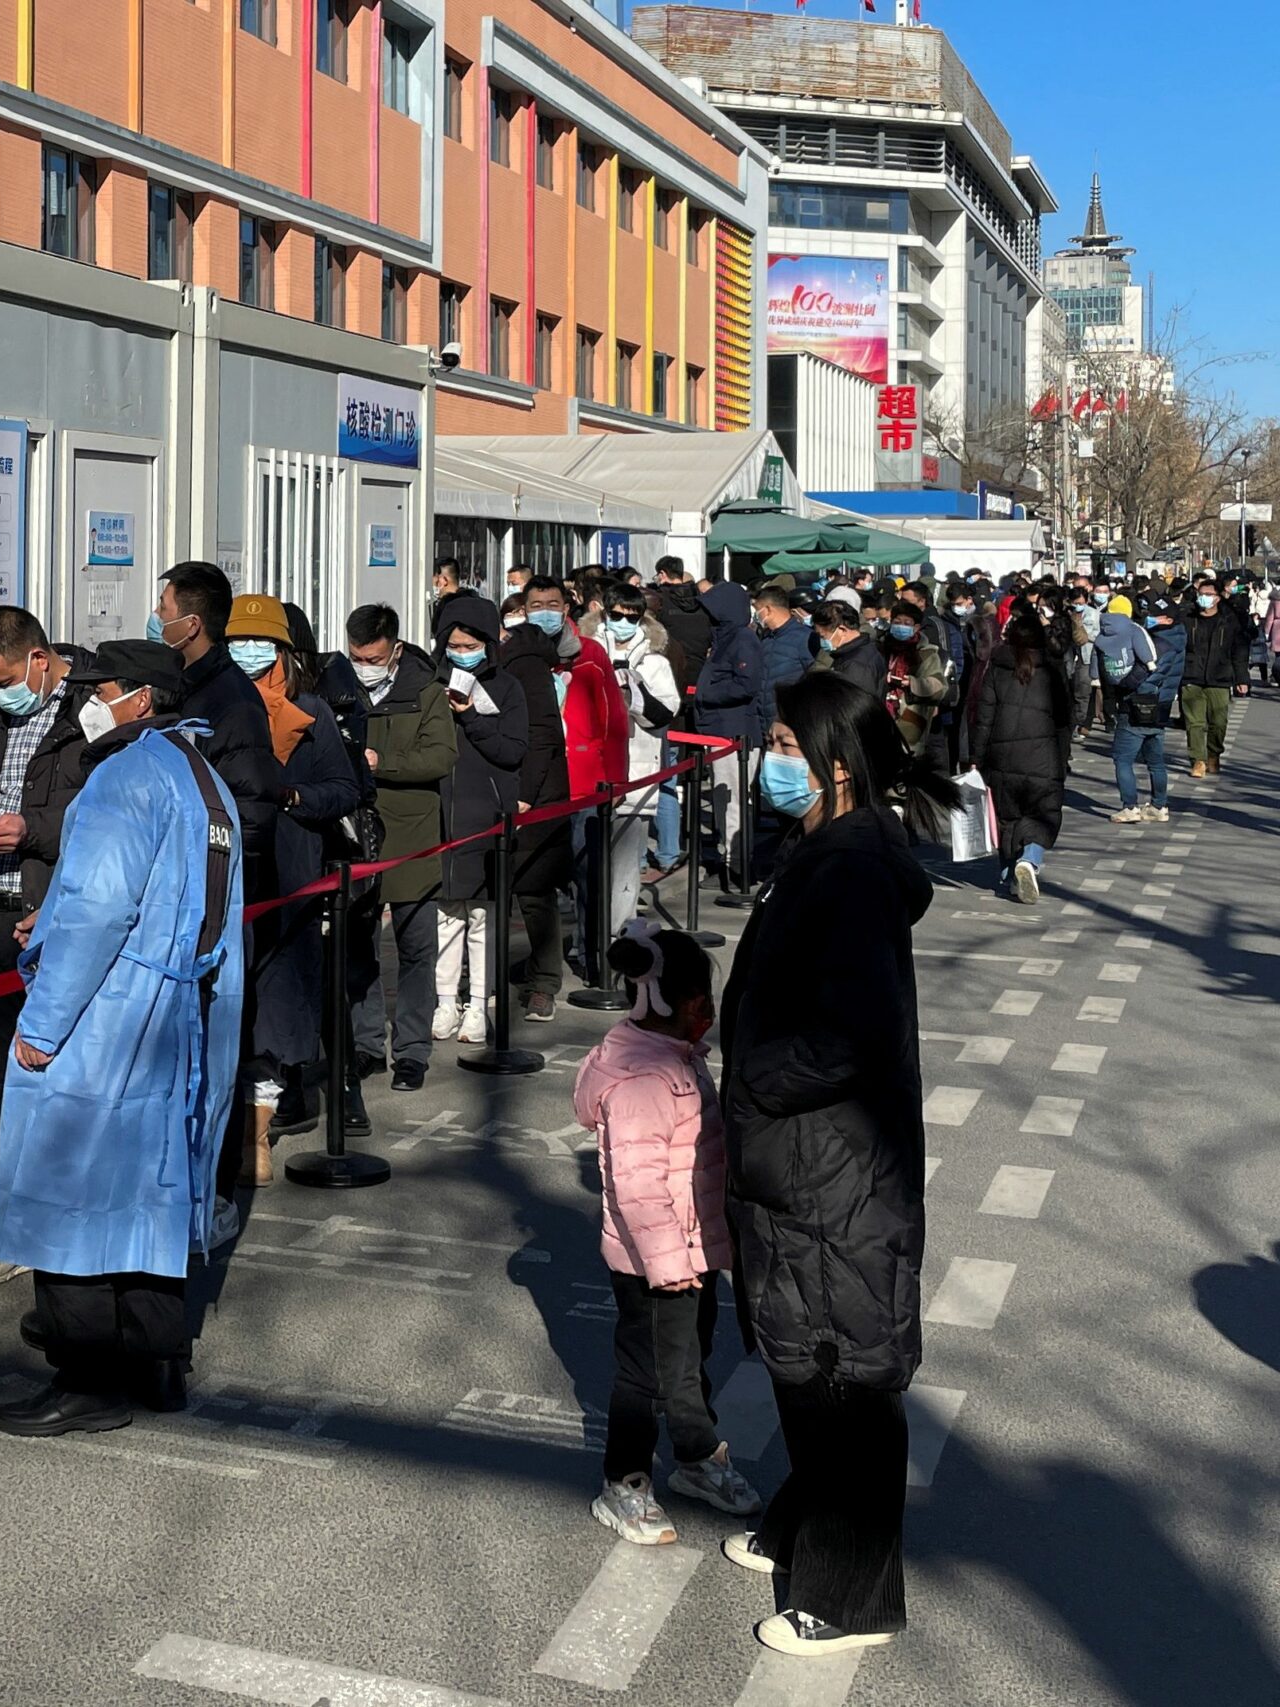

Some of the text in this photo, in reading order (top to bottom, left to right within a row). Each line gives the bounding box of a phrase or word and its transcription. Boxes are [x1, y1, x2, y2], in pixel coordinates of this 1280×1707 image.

[346, 397, 417, 449] 核酸检测门诊
[877, 385, 917, 453] 超市
